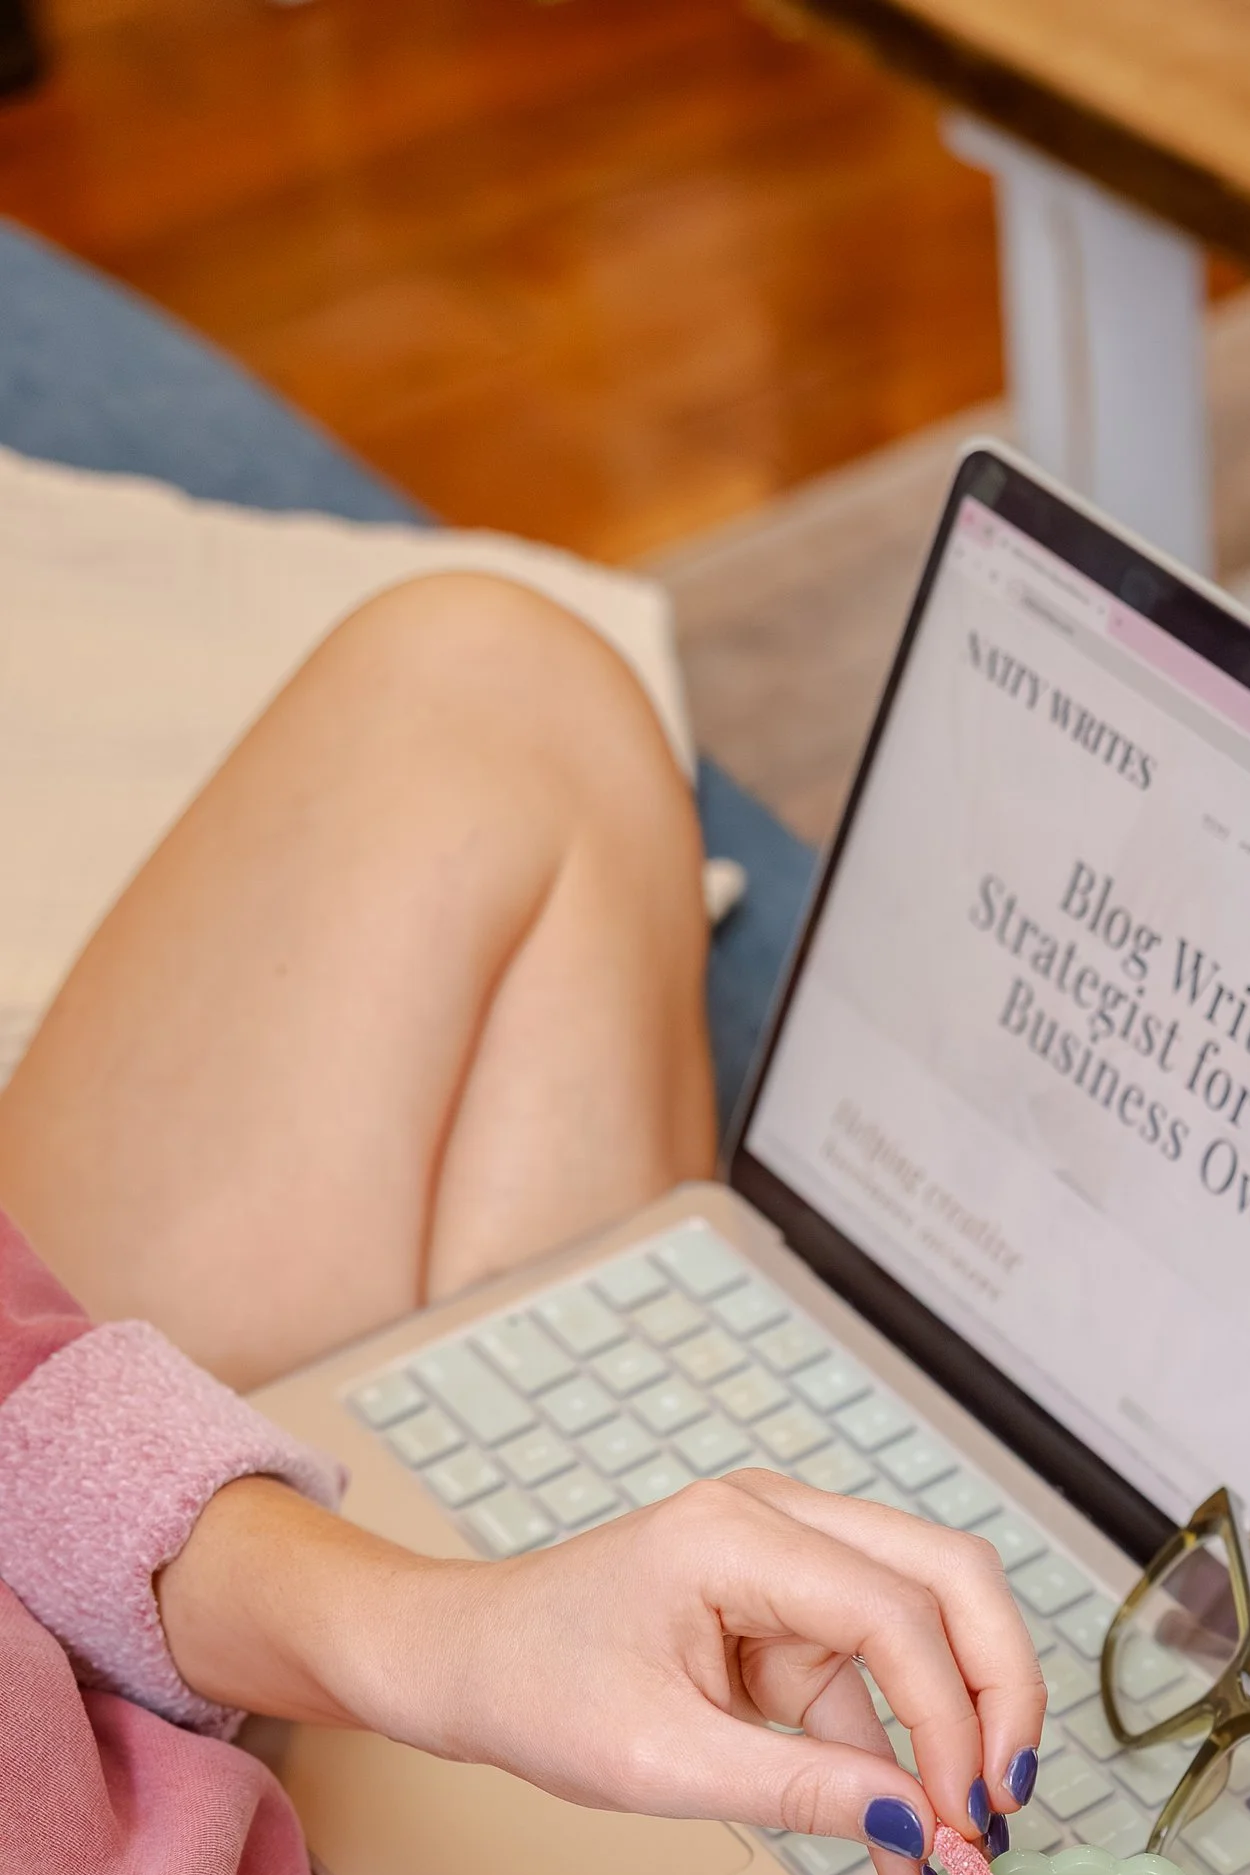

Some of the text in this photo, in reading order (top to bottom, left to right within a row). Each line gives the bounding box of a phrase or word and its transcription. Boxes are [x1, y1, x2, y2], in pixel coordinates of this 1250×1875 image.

[1050, 687, 1158, 791] WRITES
[967, 873, 1184, 1073] Strategist
[1059, 860, 1161, 982] Blog
[999, 977, 1190, 1163] Business
